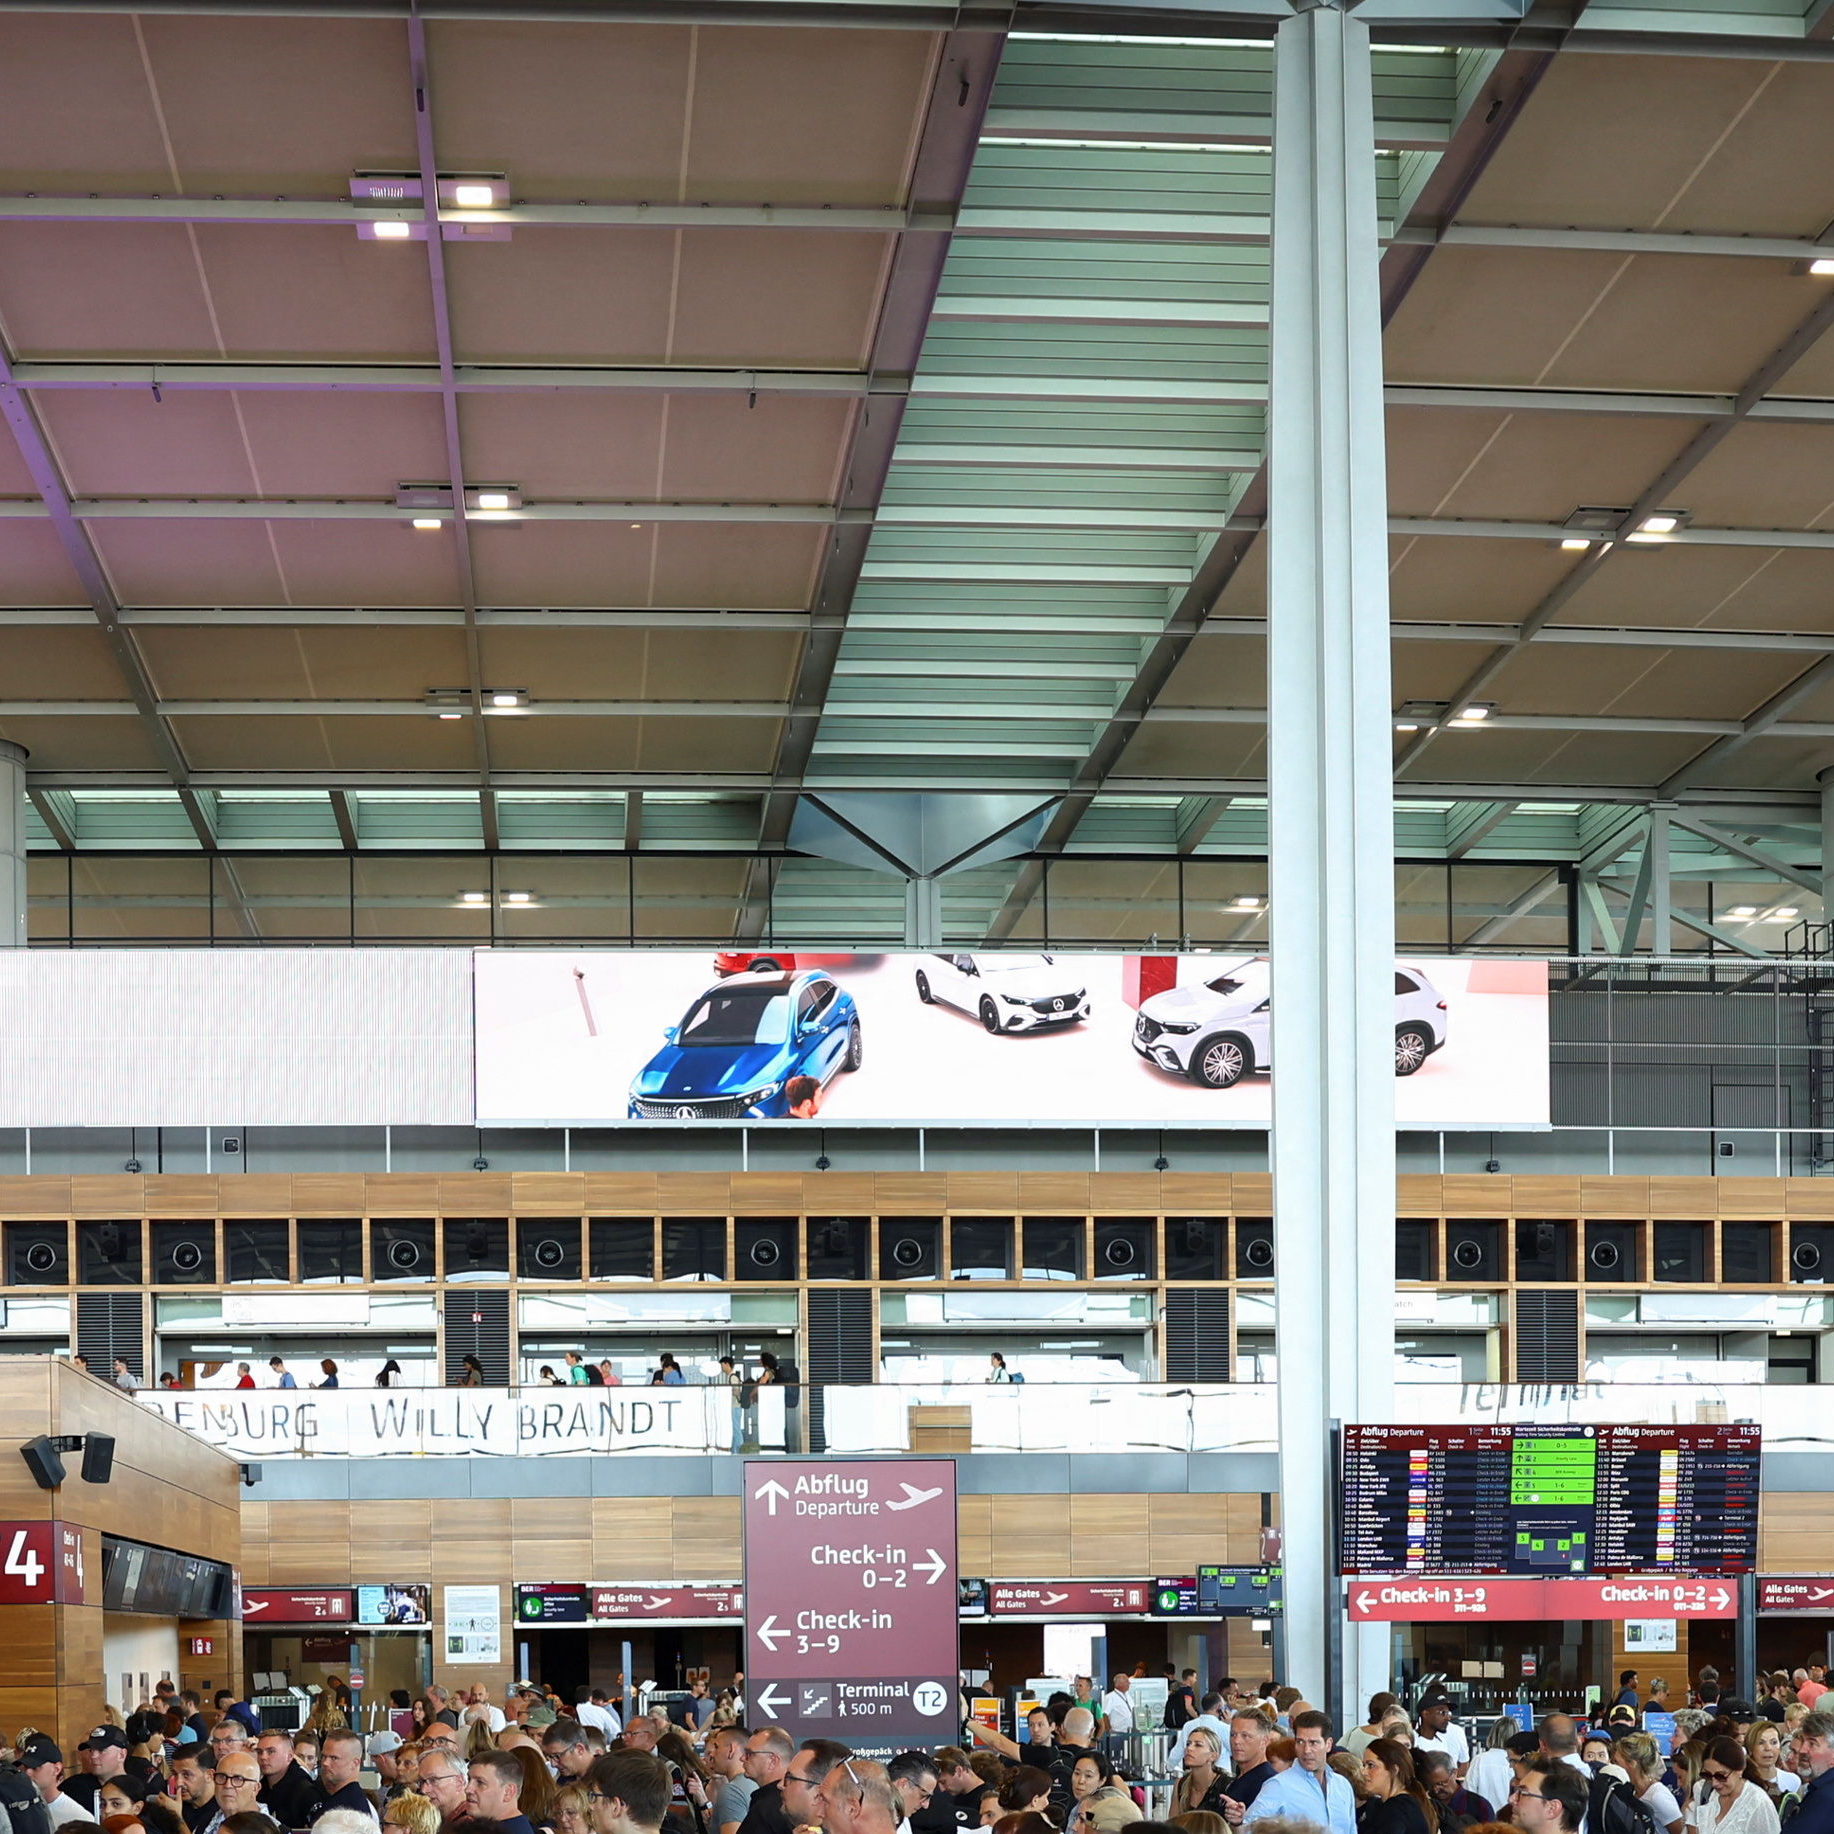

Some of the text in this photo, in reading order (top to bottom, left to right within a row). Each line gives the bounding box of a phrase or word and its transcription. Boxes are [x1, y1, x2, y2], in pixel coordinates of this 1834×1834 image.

[370, 1398, 494, 1441] WILLY
[519, 1400, 682, 1440] BRANDT
[1361, 1427, 1512, 1438] Abflug Departure 11:55
[1612, 1427, 1760, 1437] Abflug Departure 2 11:55
[794, 1474, 869, 1499] Abflug
[795, 1500, 880, 1519] Departure
[4, 1530, 45, 1587] 4
[810, 1545, 907, 1565] Check-in
[862, 1569, 907, 1588] 0–2
[996, 1589, 1040, 1598] Alle Gates
[1380, 1587, 1486, 1604] Check-in 3–9
[1601, 1586, 1706, 1602] Check-in 0–2
[1765, 1584, 1808, 1594] Alle Gates
[597, 1593, 643, 1603] Alle Gates
[996, 1600, 1027, 1608] All Gates
[1765, 1595, 1795, 1603] All Gates
[796, 1609, 893, 1629] Check-in
[796, 1635, 841, 1654] 3–9
[836, 1682, 942, 1707] Terminal T2
[851, 1703, 893, 1715] 500 m
